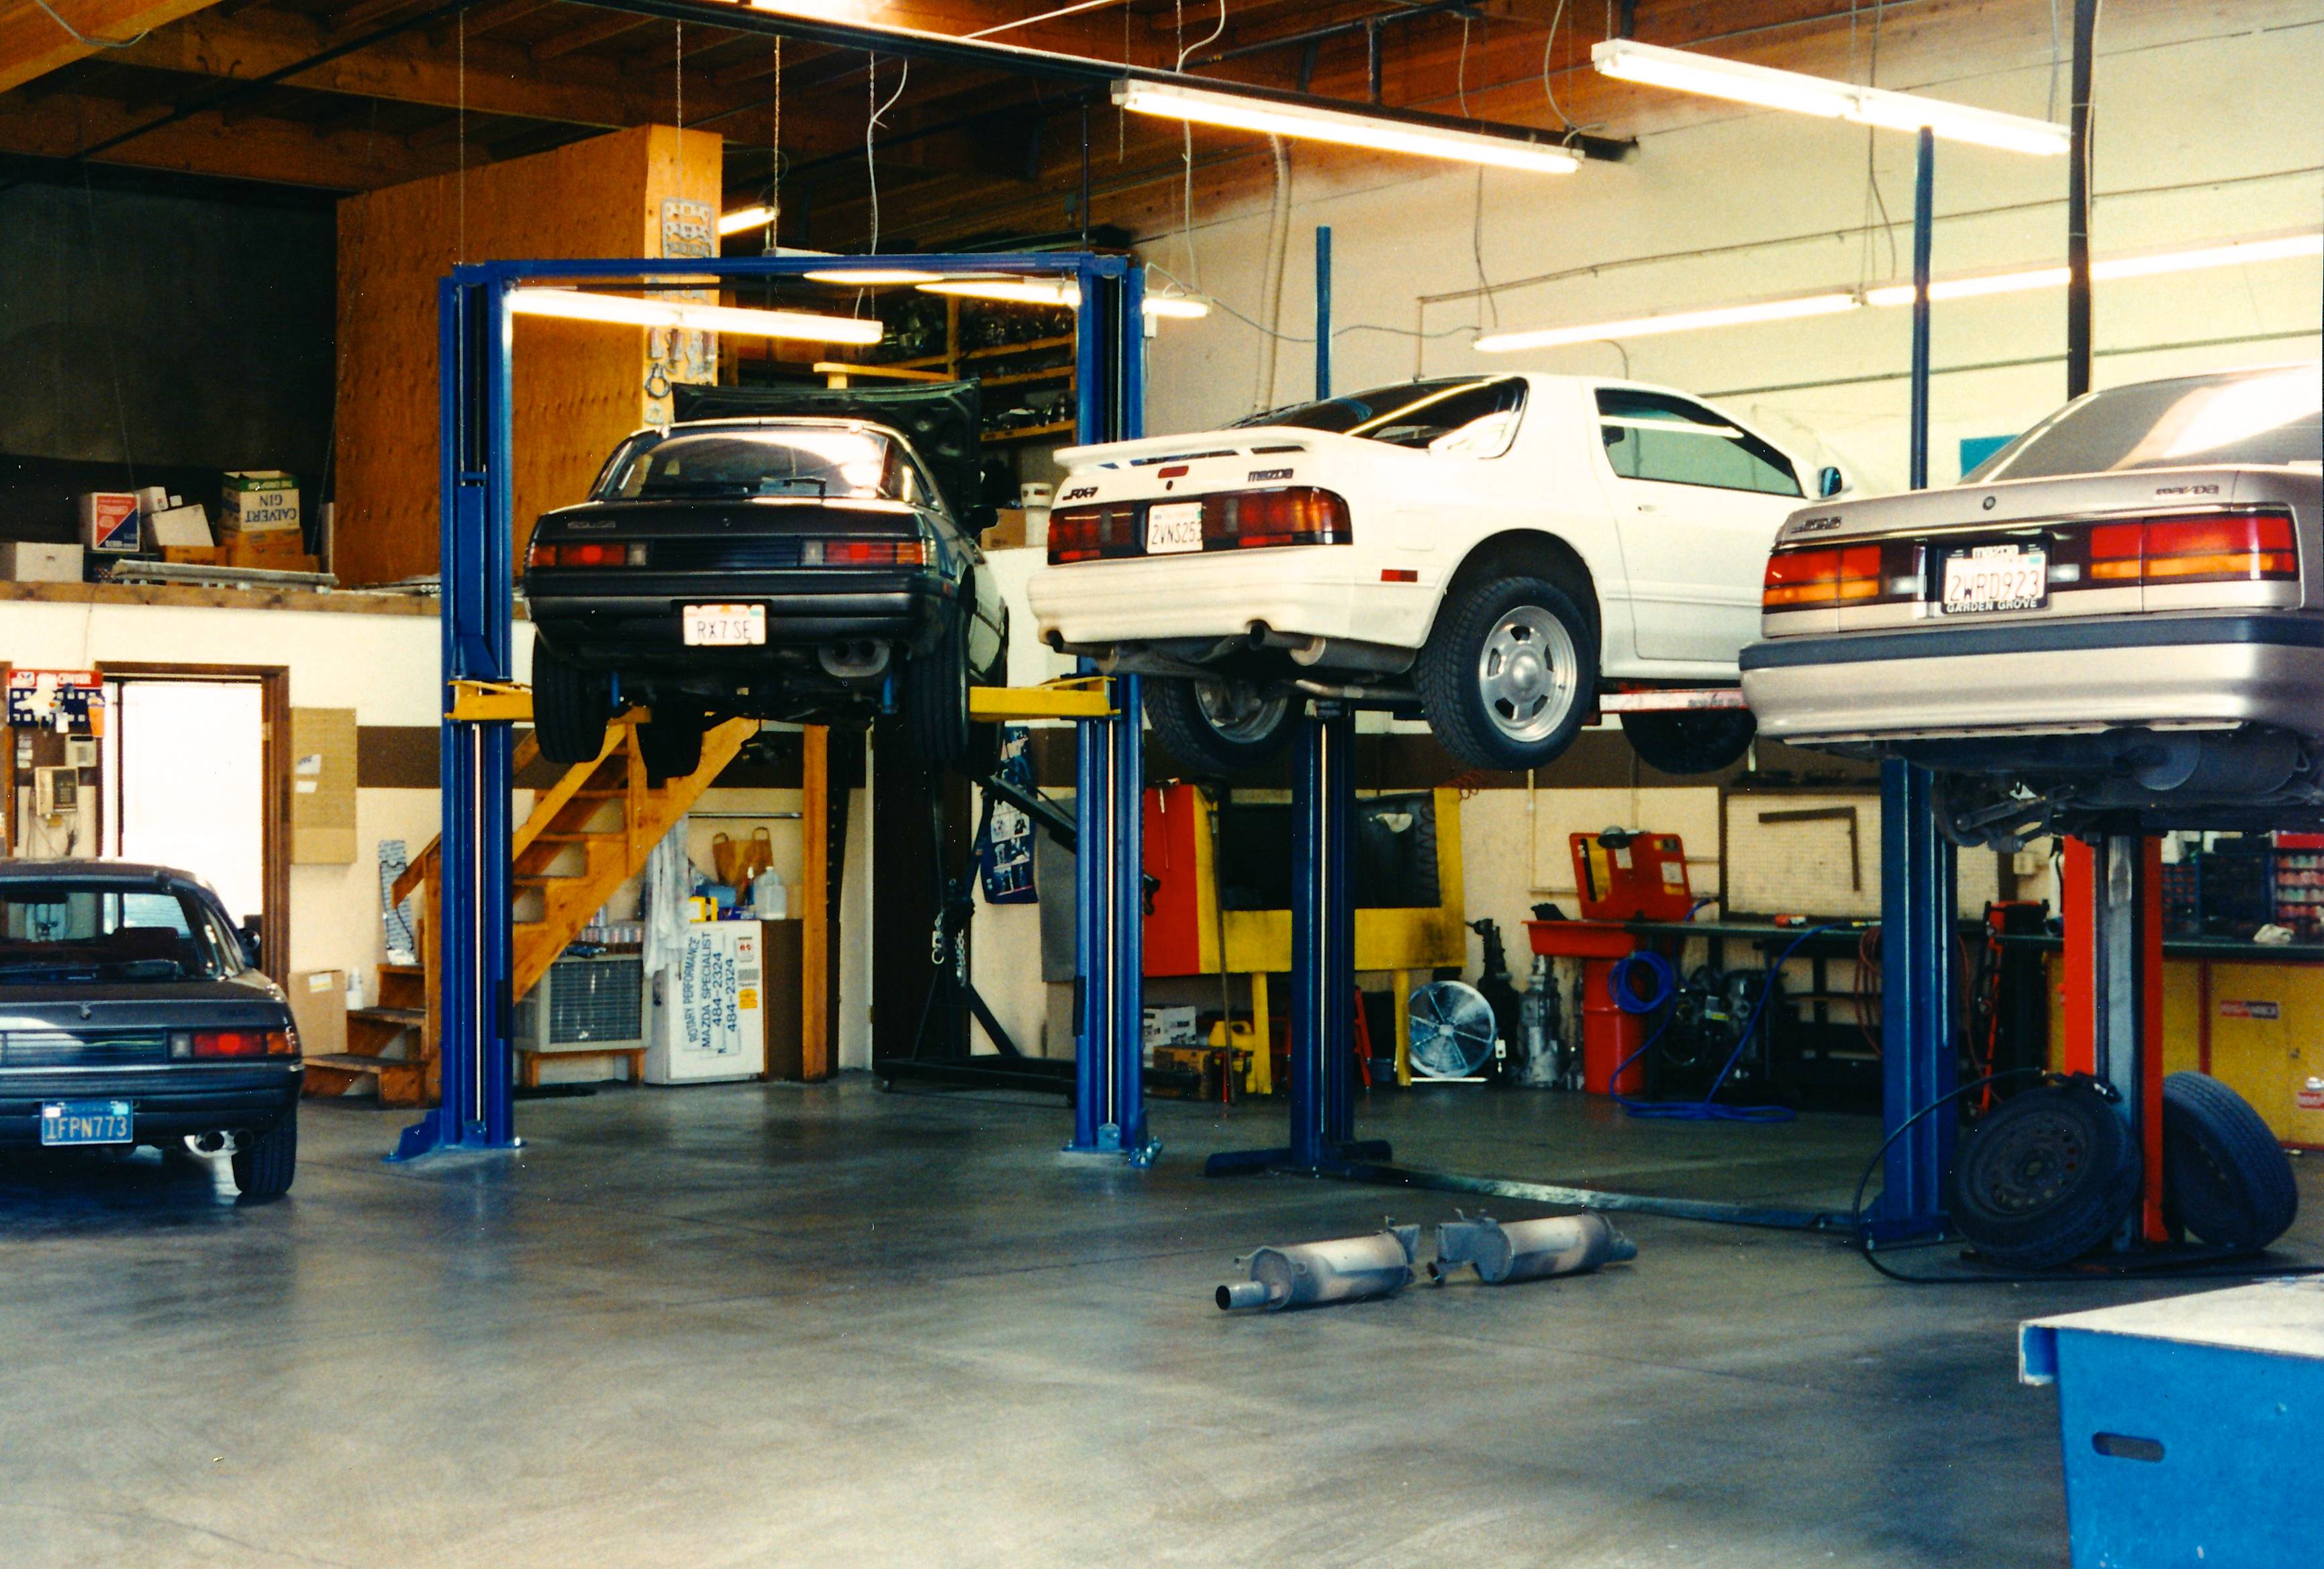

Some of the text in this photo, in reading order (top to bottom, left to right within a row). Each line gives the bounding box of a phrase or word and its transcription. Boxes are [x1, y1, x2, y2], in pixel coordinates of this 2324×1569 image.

[260, 494, 283, 507] GIN
[245, 507, 297, 523] CALVERT
[1949, 570, 2039, 601] 2WRD923
[1946, 597, 2038, 613] GARDEN GROVE
[732, 619, 752, 640] SE
[683, 936, 700, 1043] ROTARY PERFORMANCE
[700, 931, 712, 1048] MAZDA SPECIALIST
[712, 952, 723, 1027] 484-2324
[725, 958, 738, 1032] 484-2324
[48, 1116, 128, 1140] 1FPN773
